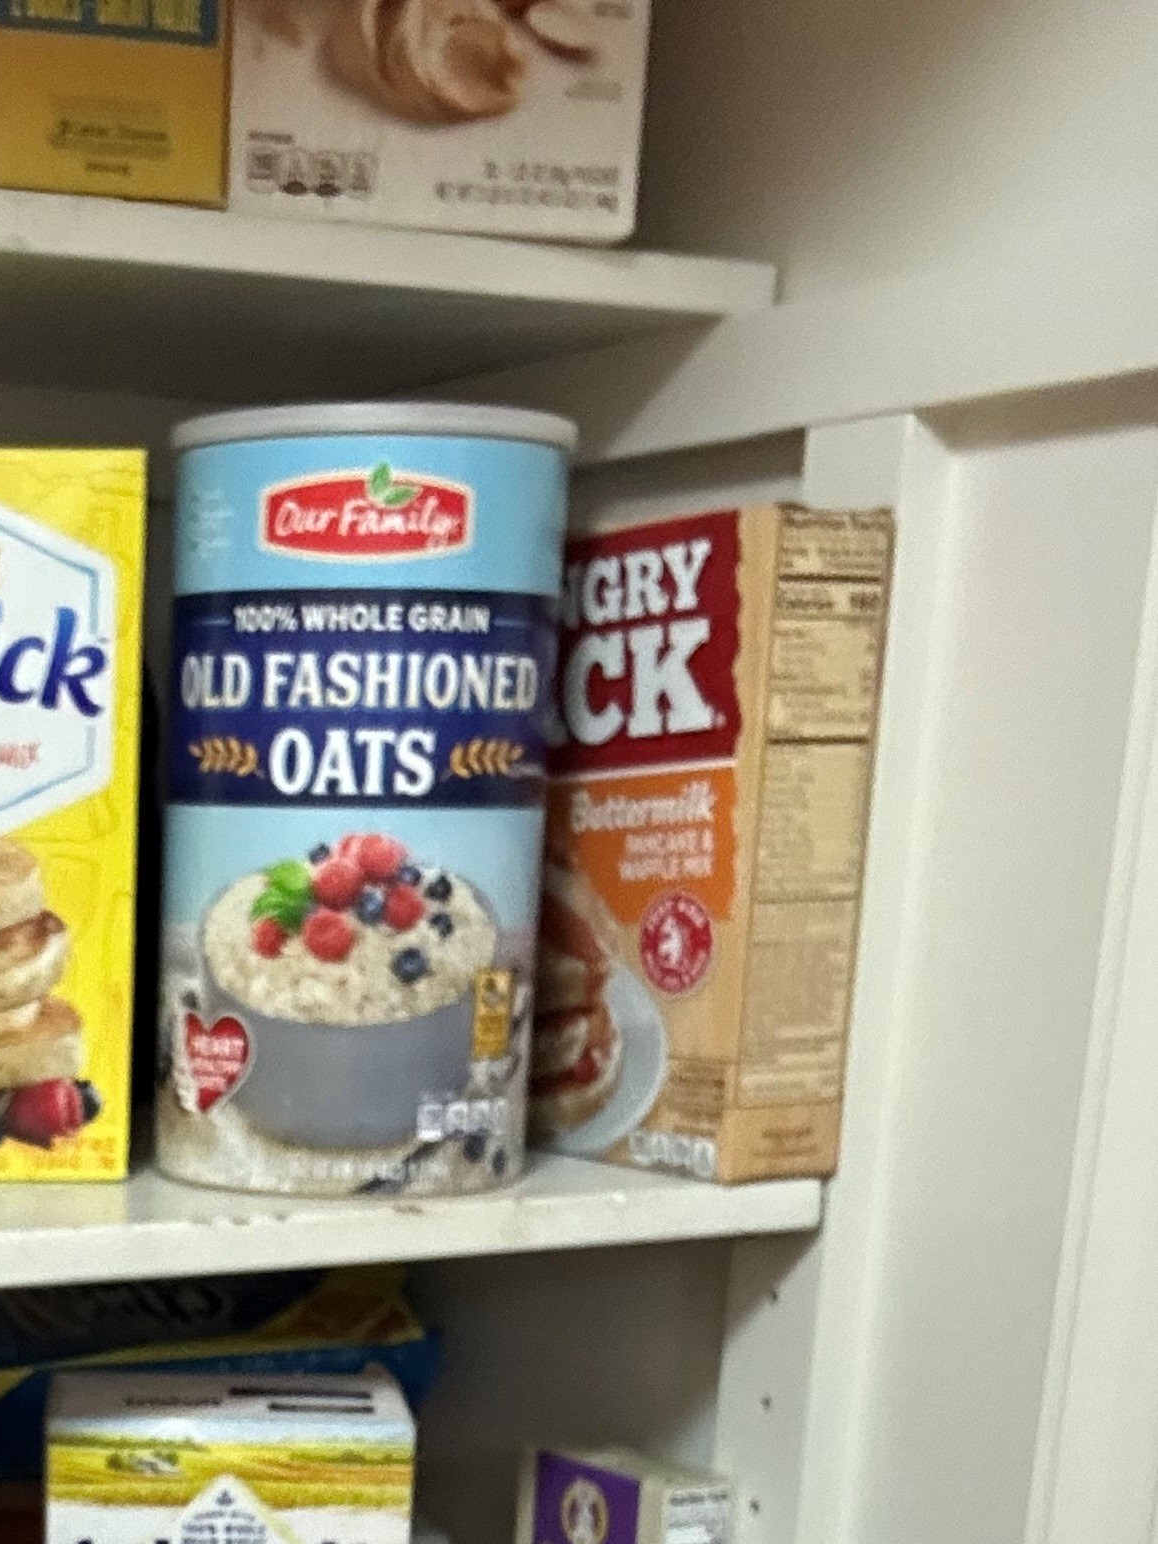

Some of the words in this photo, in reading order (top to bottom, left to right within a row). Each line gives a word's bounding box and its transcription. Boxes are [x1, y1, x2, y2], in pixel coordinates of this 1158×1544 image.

[275, 500, 336, 537] Our
[342, 495, 462, 552] Family
[235, 604, 298, 633] 100%
[302, 604, 404, 633] WHOLE
[408, 604, 492, 634] GRAIN
[180, 653, 253, 710] OLD
[262, 652, 540, 712] FASHIONED
[268, 727, 437, 797] OATS
